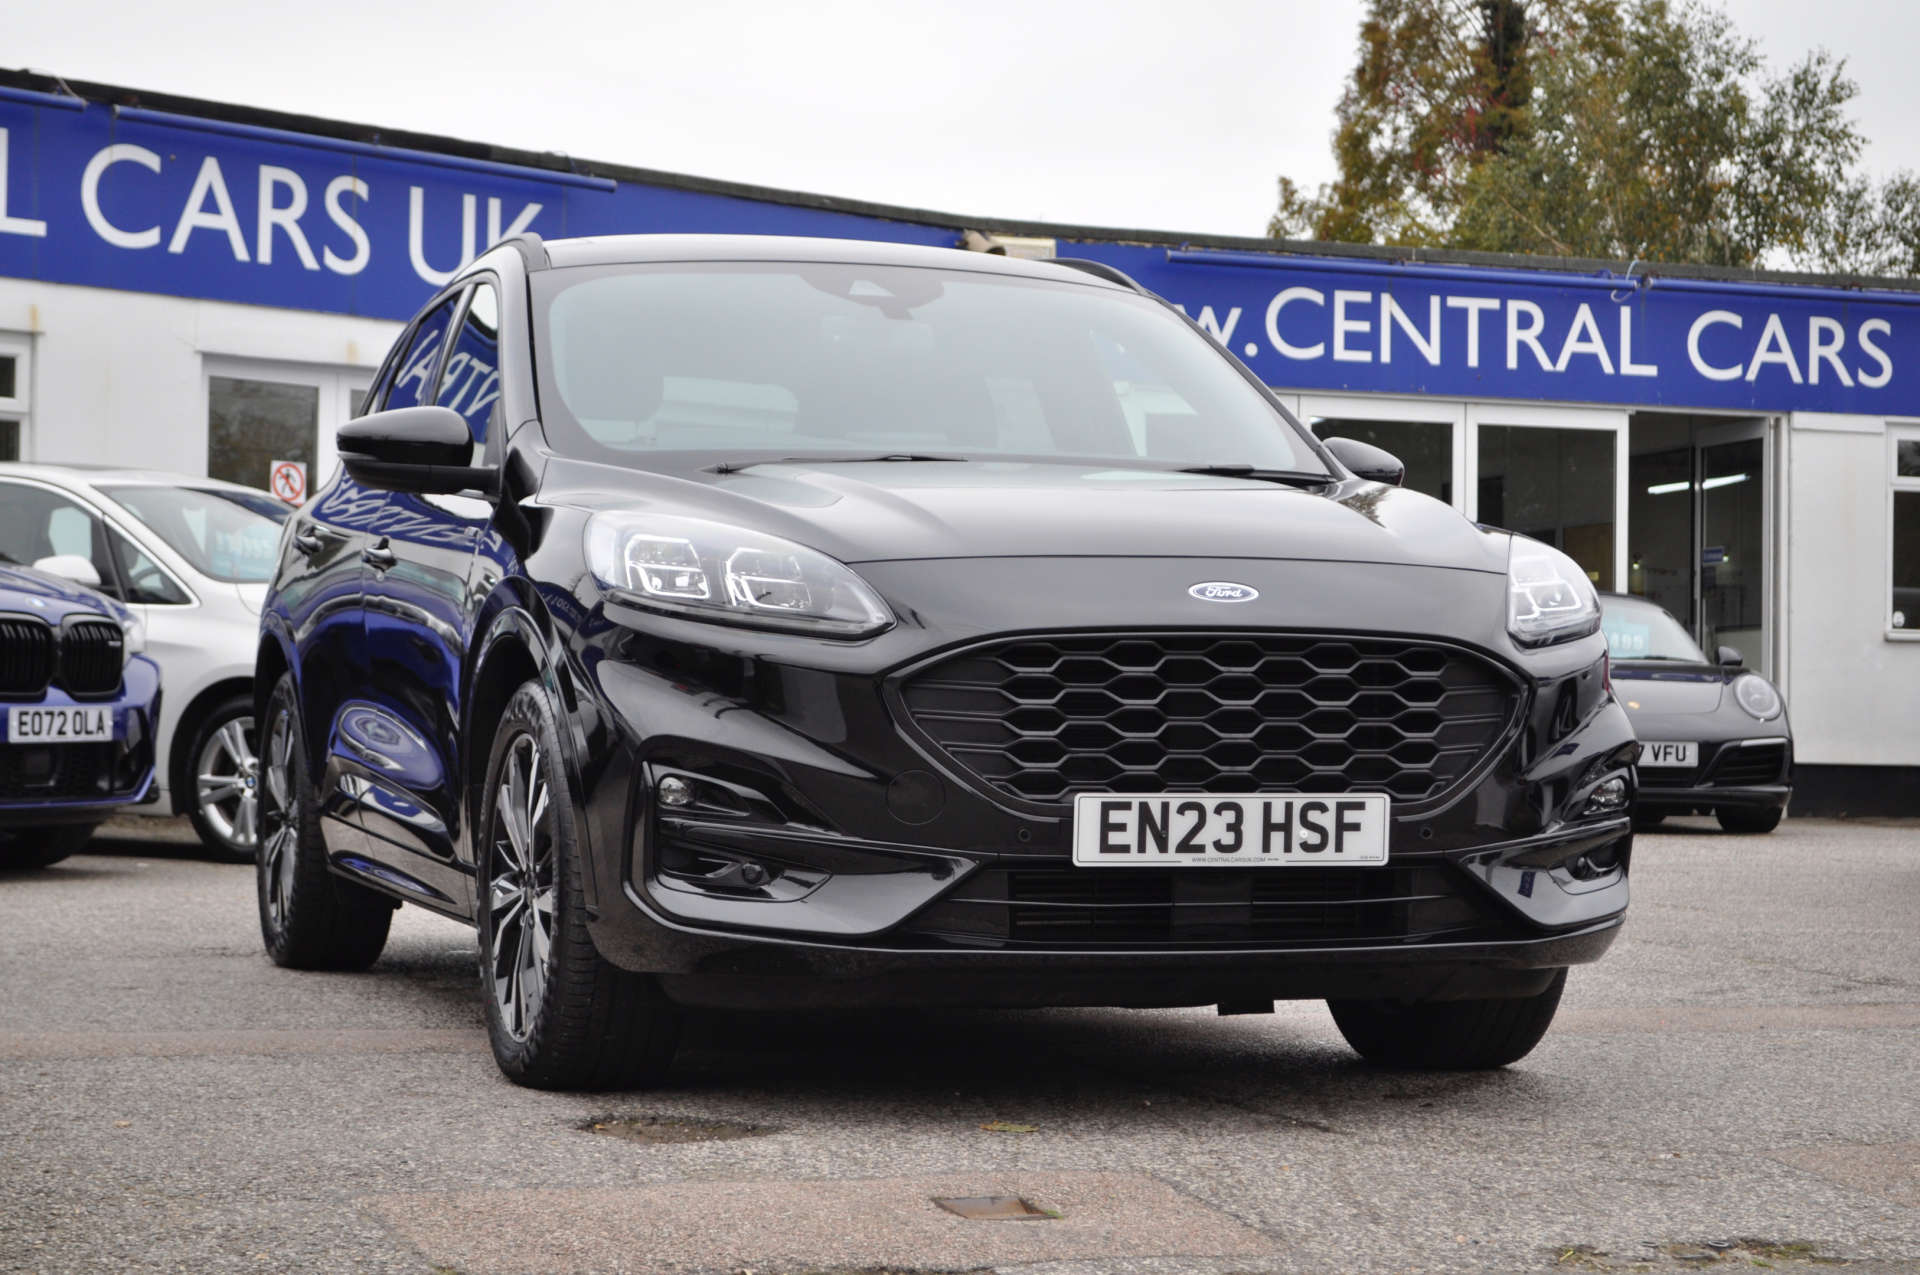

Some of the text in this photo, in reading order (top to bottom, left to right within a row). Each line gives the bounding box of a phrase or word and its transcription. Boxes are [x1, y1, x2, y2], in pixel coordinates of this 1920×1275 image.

[81, 143, 370, 276] CARS
[1687, 310, 1893, 389] CARS
[1651, 744, 1686, 762] VFU
[1099, 800, 1366, 855] EN23 HSF
